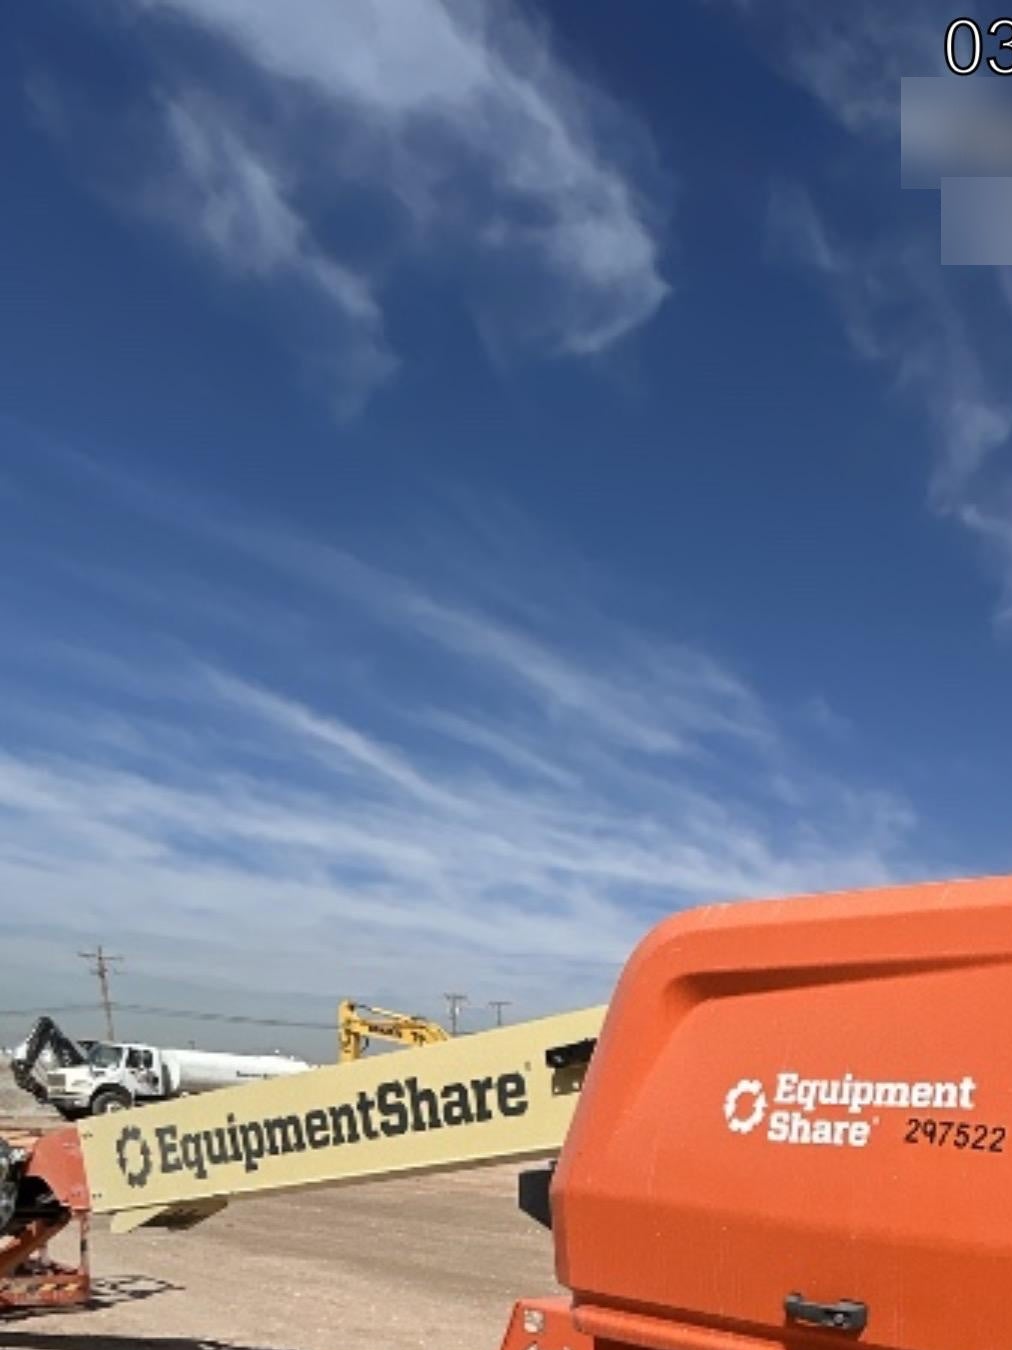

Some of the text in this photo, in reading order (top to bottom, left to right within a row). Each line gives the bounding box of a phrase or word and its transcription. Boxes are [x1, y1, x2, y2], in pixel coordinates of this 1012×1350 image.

[774, 1072, 977, 1113] Equipment
[156, 1071, 529, 1180] EquipmentShare
[767, 1112, 871, 1147] Share
[904, 1118, 1007, 1153] 297522
